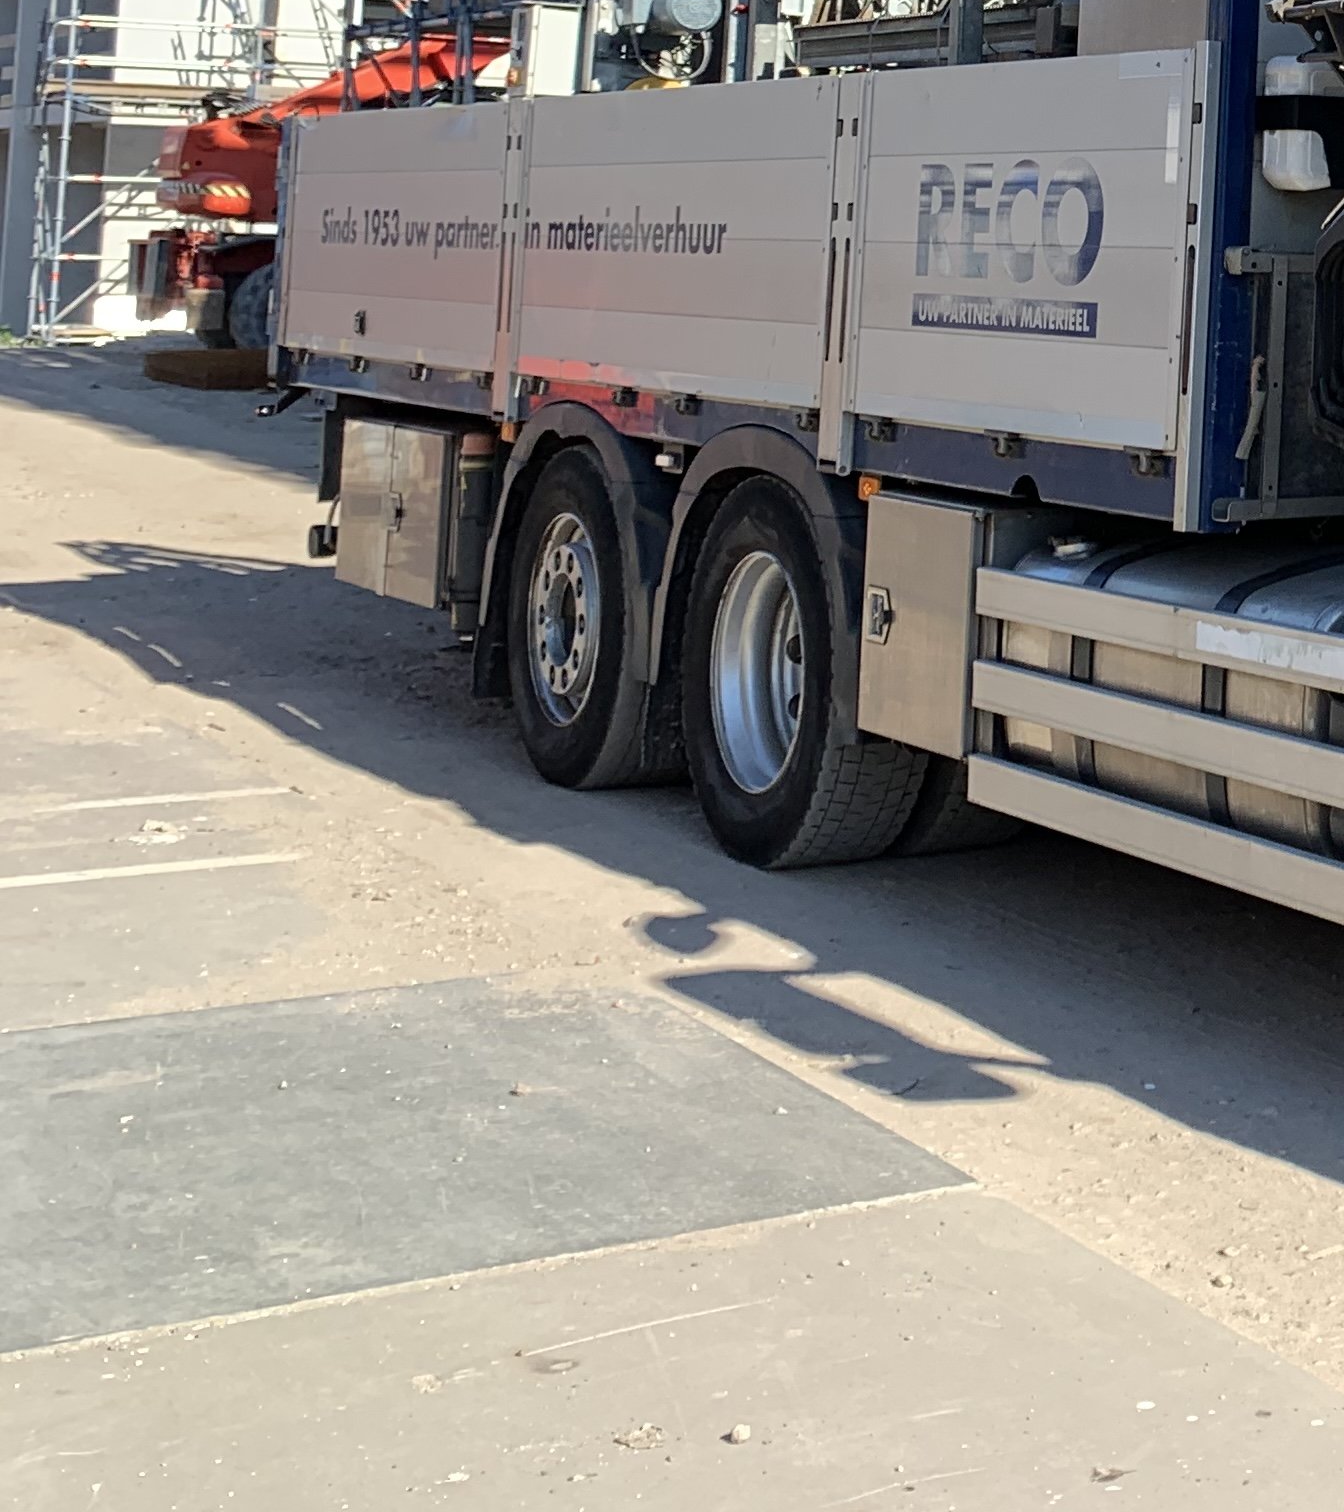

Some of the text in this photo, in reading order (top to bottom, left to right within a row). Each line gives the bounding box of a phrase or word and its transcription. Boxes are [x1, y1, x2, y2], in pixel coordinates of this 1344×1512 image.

[321, 206, 357, 246] Sinds
[362, 208, 400, 247] 1953
[404, 220, 430, 246] uw
[523, 208, 541, 250] in
[547, 205, 727, 254] materieelverhuur
[915, 156, 1104, 286] RECO
[918, 300, 1090, 332] UW PARTNER IN MATERIEEL
